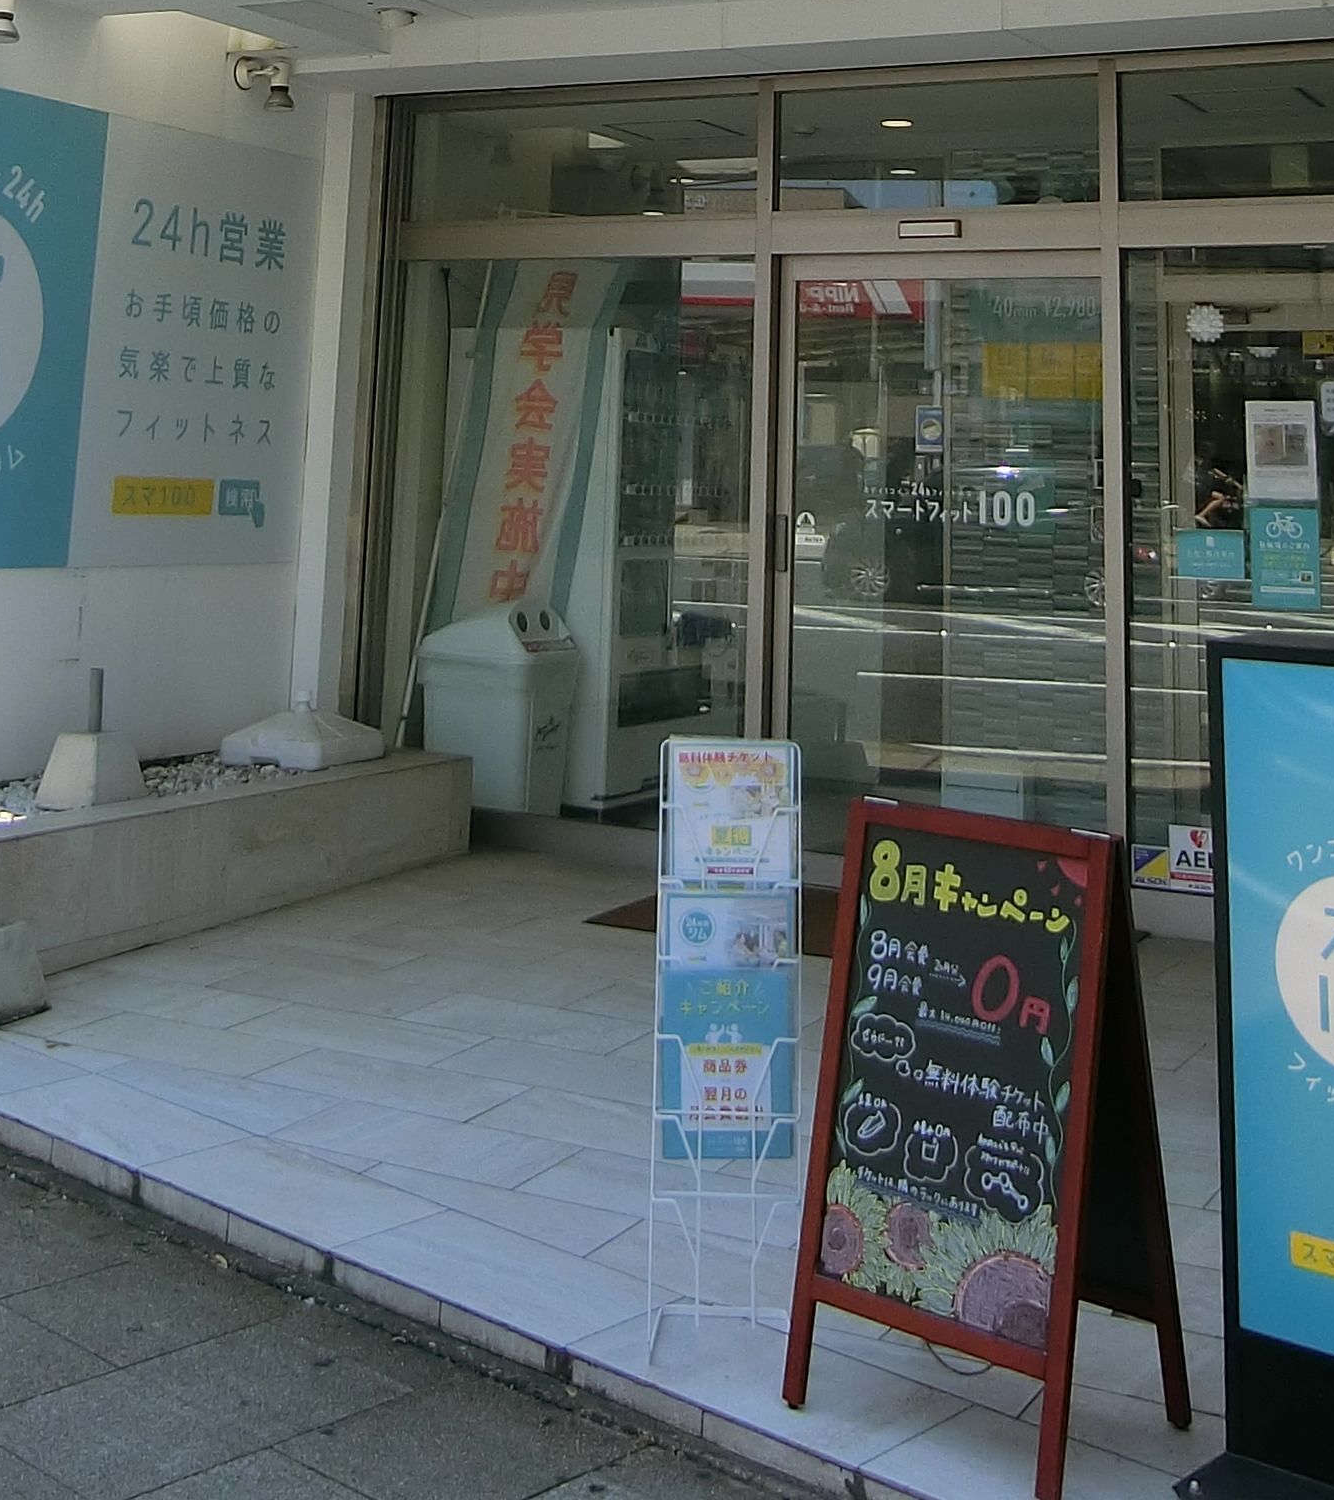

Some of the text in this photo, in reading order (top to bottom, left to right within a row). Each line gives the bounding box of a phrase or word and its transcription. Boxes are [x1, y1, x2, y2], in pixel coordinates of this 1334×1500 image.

[130, 197, 288, 272] 24h営業
[125, 289, 282, 337] お手頃価格の
[117, 345, 278, 392] 気楽で上質な
[116, 409, 274, 447] フィットネス
[869, 839, 1071, 933] 8月キャンペーン
[680, 1000, 769, 1016] キャンペーン
[701, 980, 750, 996] ご紹介
[924, 1059, 1045, 1112] 無料体験チケット
[992, 1105, 1050, 1145] 配布中
